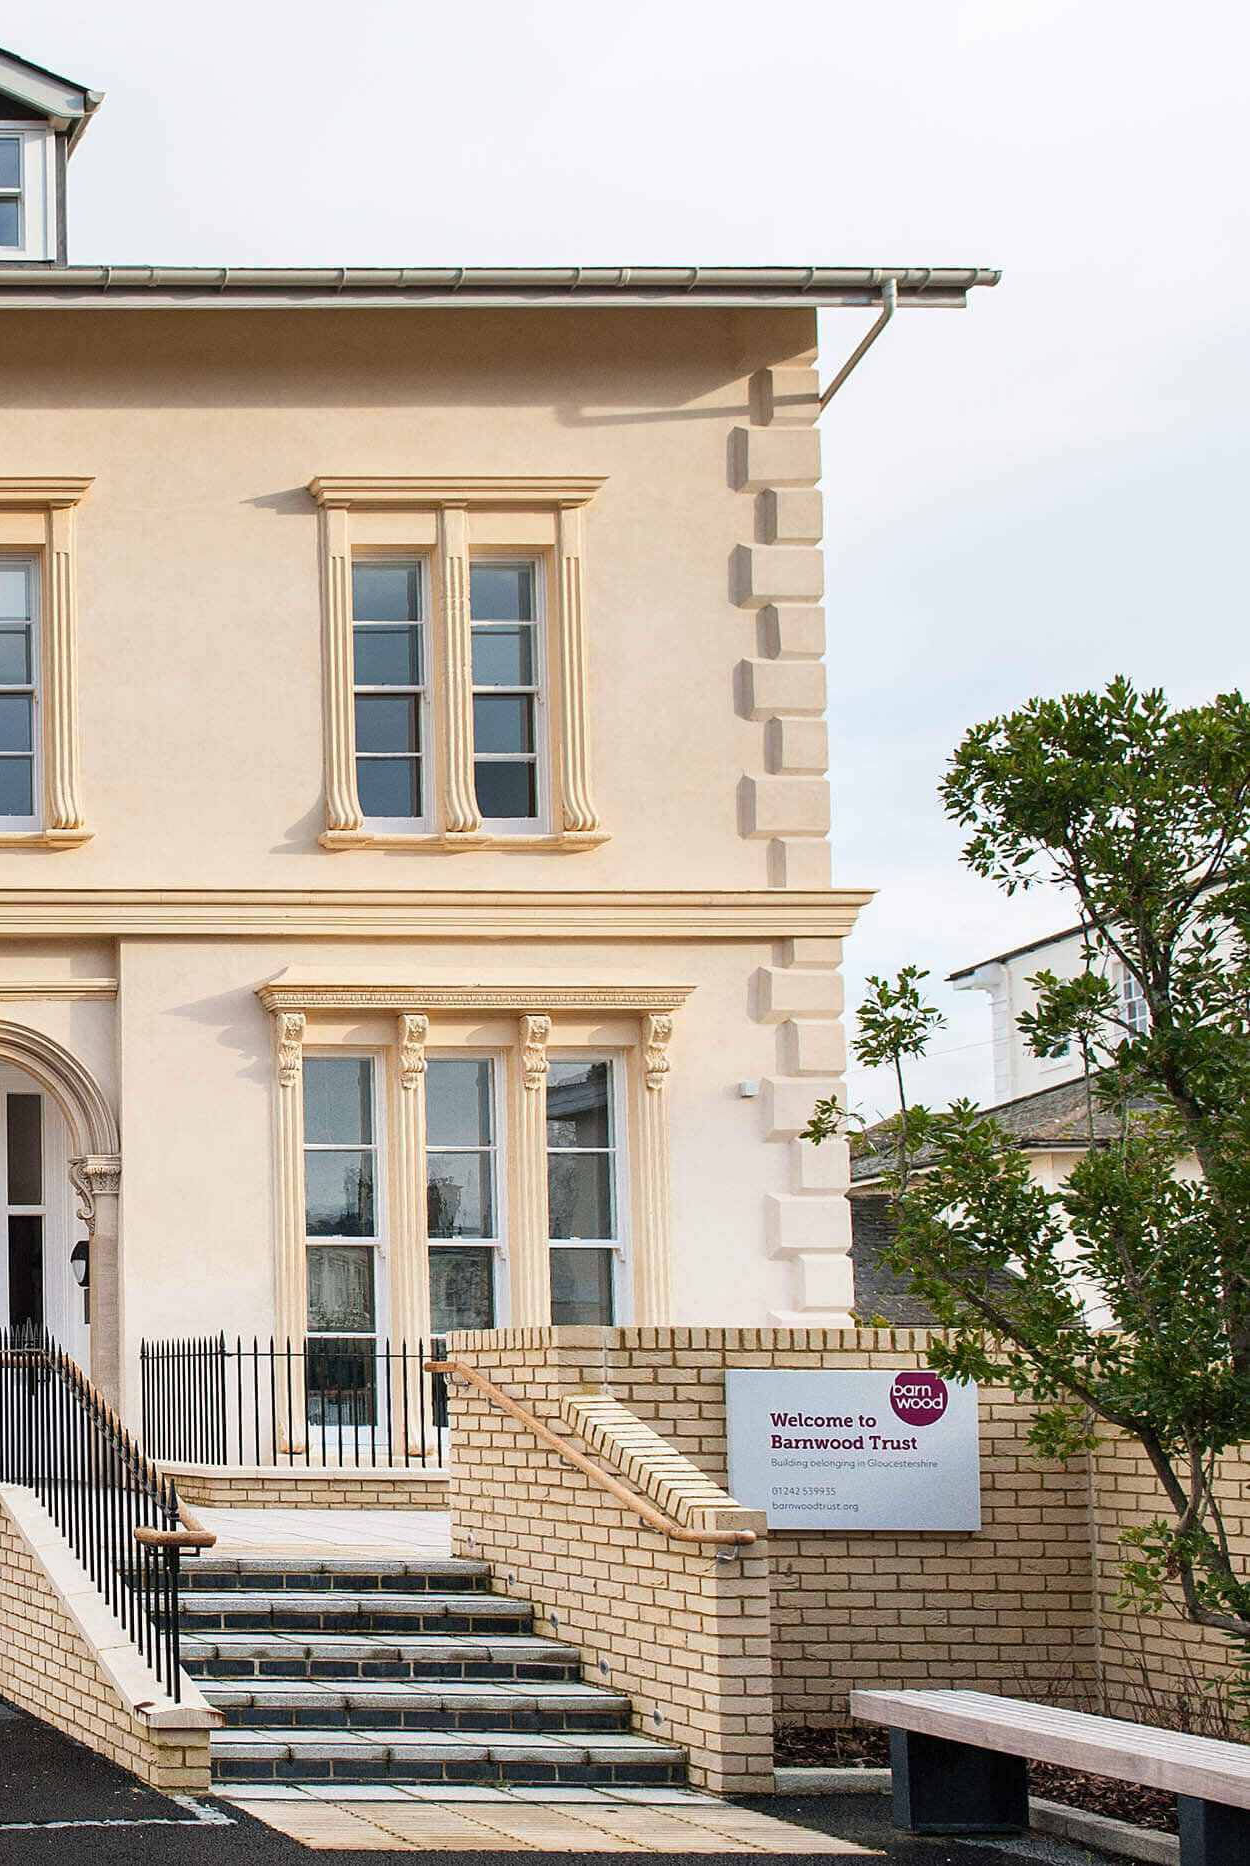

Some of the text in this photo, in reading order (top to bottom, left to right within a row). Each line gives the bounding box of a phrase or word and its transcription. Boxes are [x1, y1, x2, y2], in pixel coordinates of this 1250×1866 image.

[893, 1383, 932, 1397] barn
[894, 1392, 944, 1410] wood
[770, 1412, 877, 1428] Welcome to
[770, 1434, 918, 1451] Barnwood Trust
[770, 1458, 939, 1469] Building belonging in Gloucestershire
[771, 1486, 801, 1496] 01242
[771, 1501, 860, 1513] barnwoodtrust.org
